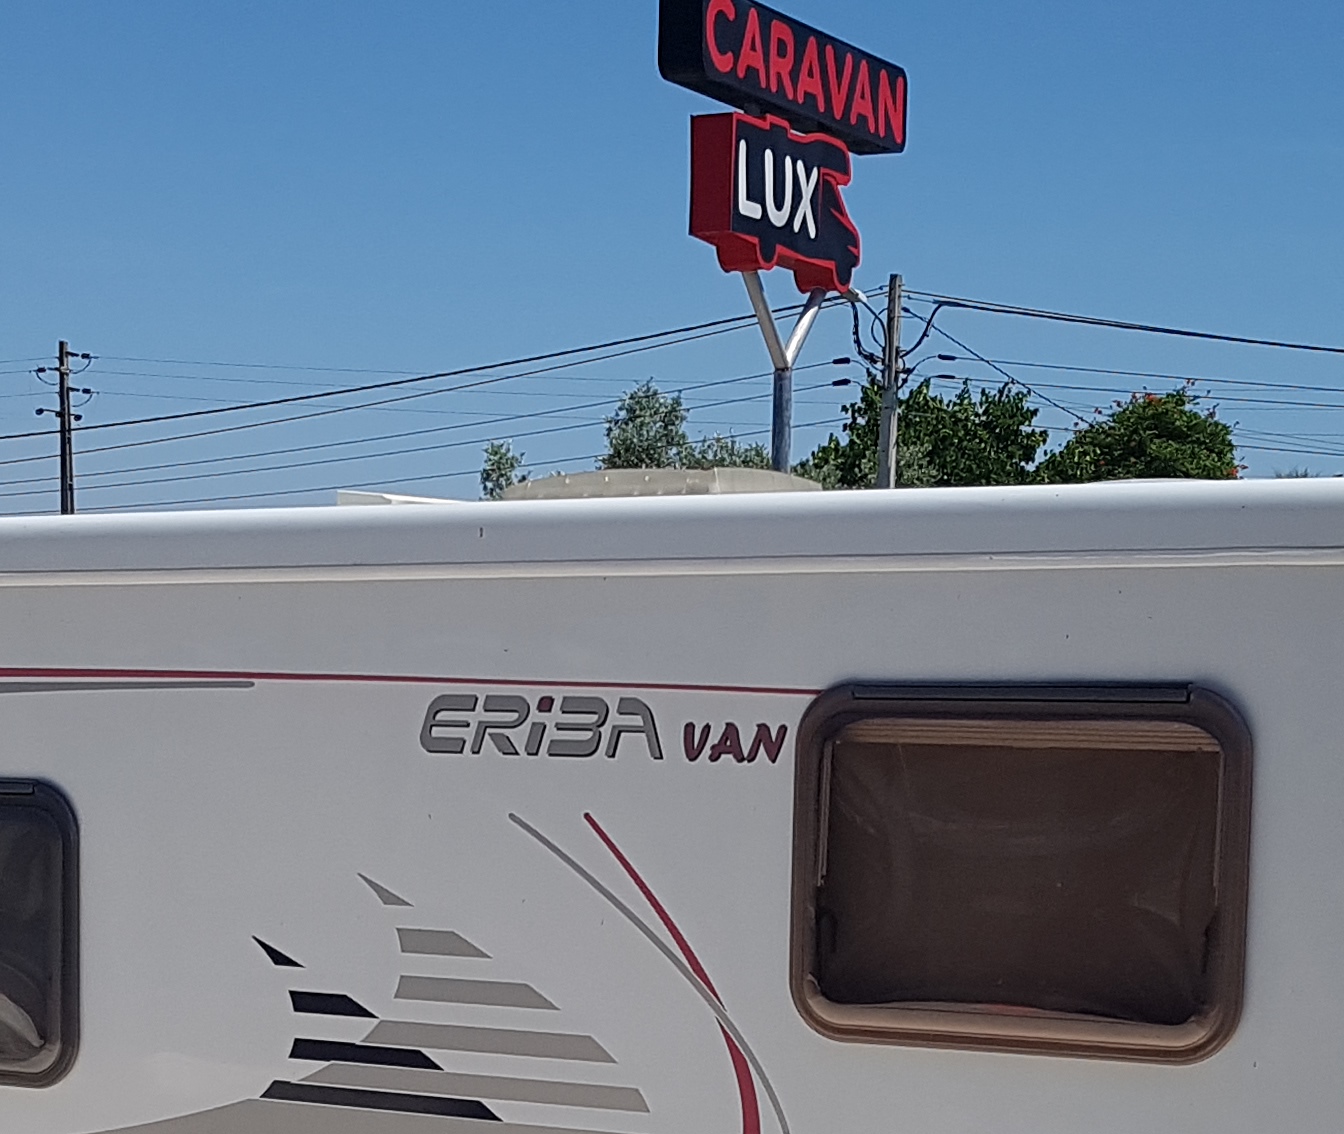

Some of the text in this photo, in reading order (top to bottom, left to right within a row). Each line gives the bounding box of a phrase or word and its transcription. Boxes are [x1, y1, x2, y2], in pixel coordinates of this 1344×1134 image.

[706, 0, 904, 144] CARAVAN
[738, 139, 820, 239] LUX
[683, 721, 788, 764] VAN
